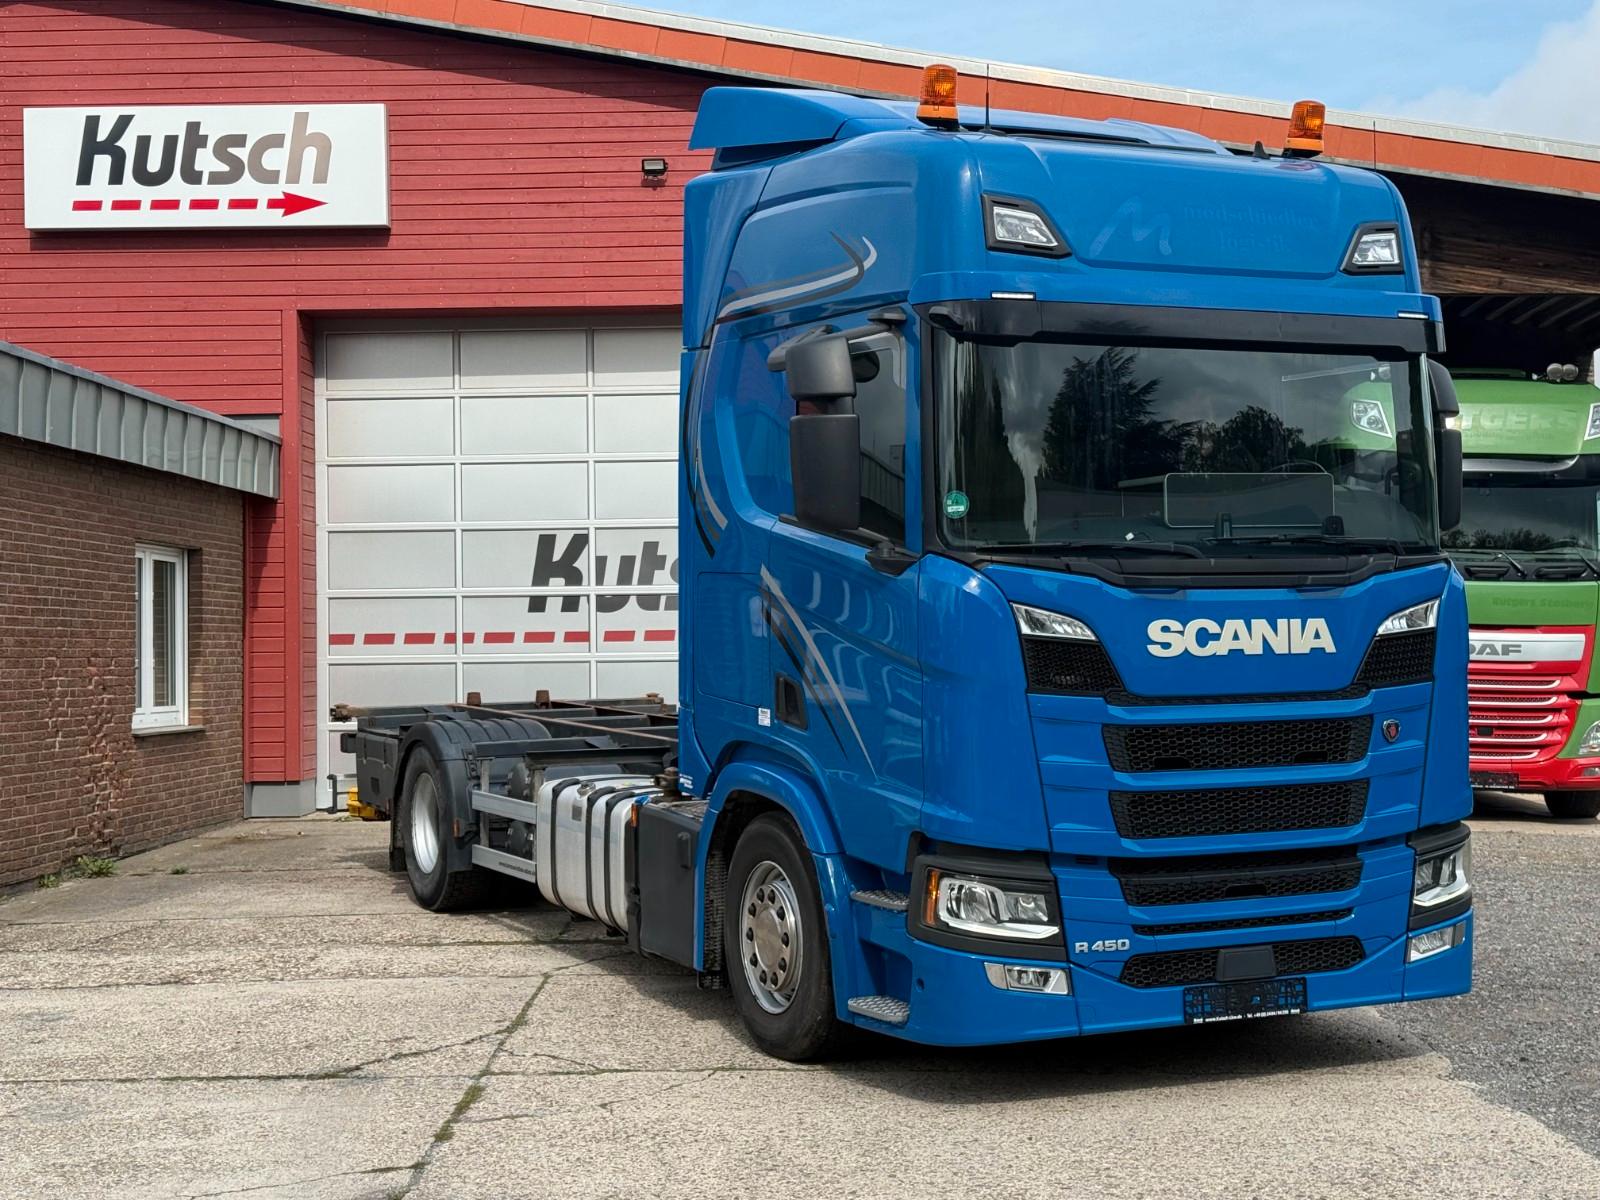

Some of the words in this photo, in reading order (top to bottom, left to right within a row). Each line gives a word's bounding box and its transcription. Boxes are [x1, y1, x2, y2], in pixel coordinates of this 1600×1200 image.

[76, 112, 332, 186] Kutsch
[1147, 618, 1337, 658] SCANIA
[1075, 942, 1089, 953] R
[1091, 939, 1130, 952] 450
